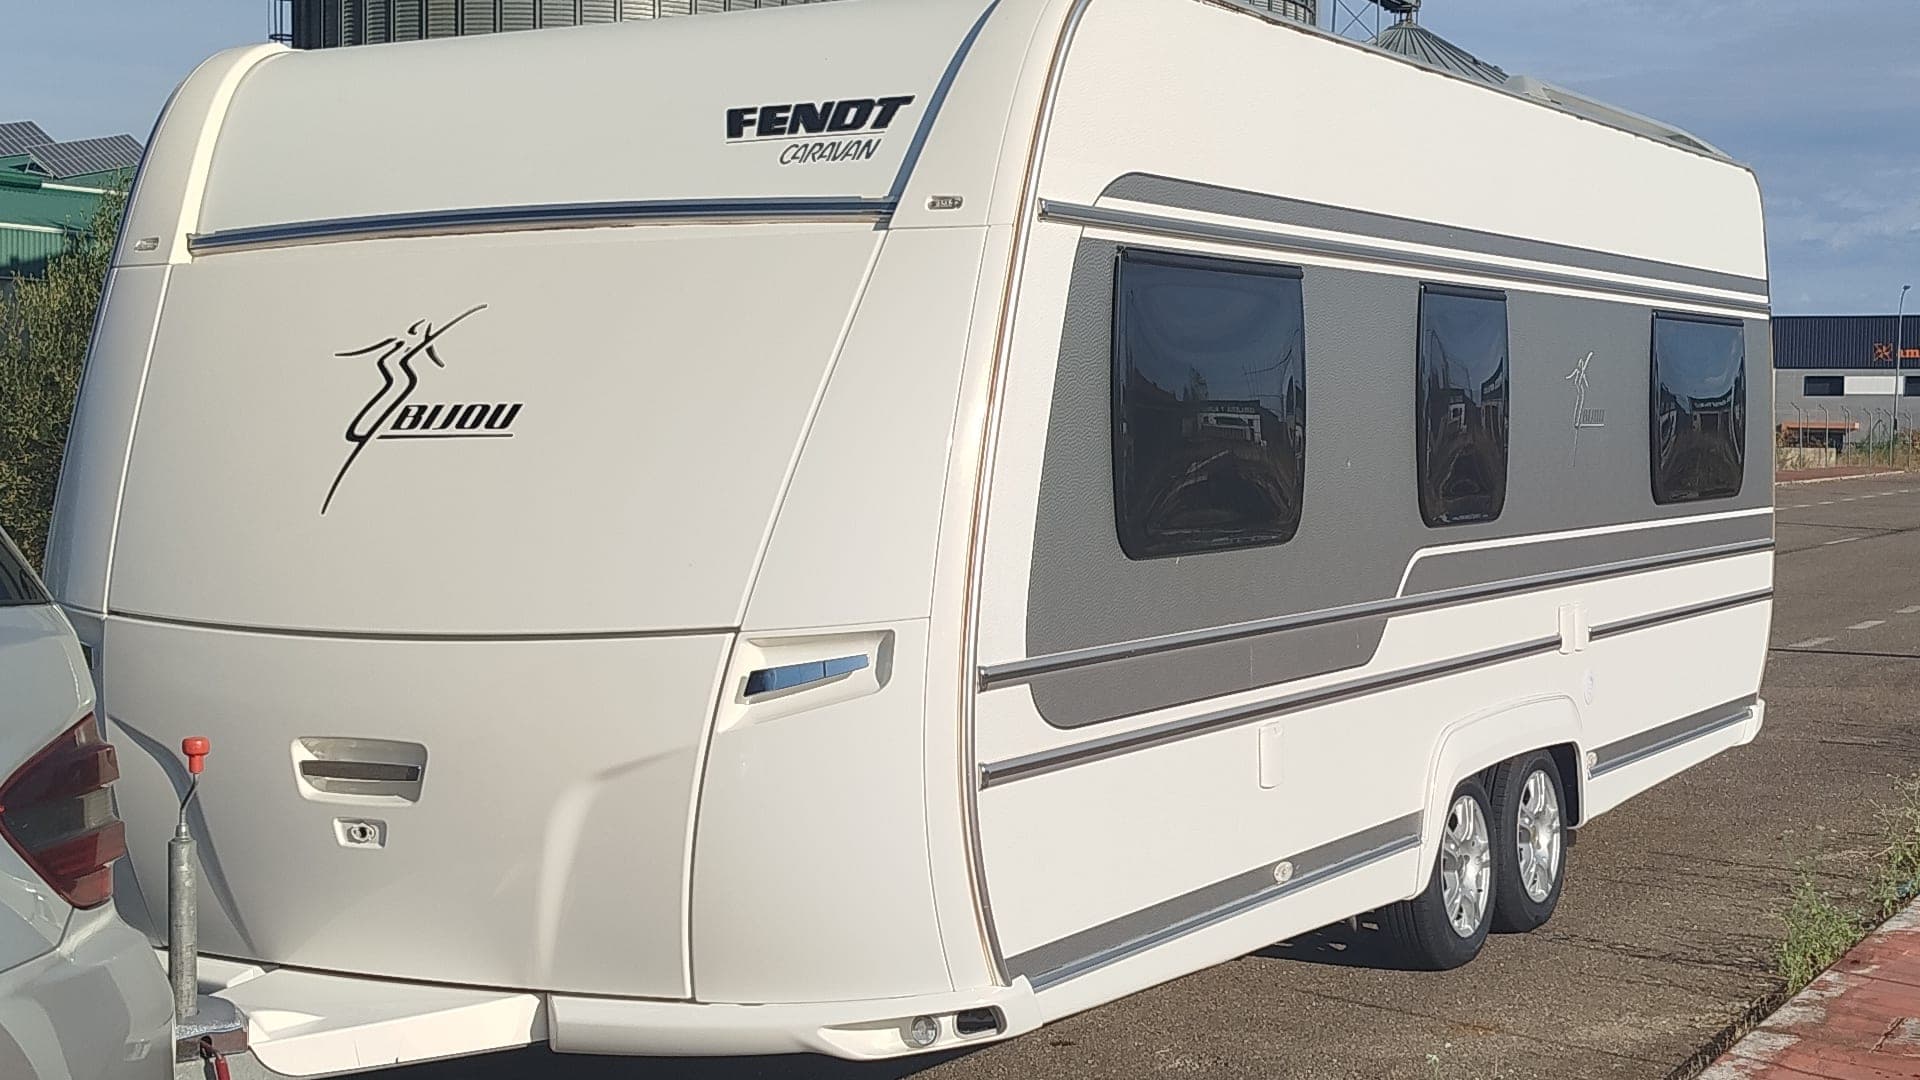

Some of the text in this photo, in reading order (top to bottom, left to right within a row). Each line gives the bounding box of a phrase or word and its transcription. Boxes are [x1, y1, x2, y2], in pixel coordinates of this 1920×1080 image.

[727, 95, 915, 138] FENDT
[780, 138, 882, 165] CARAVAN
[390, 403, 523, 430] BIJOU
